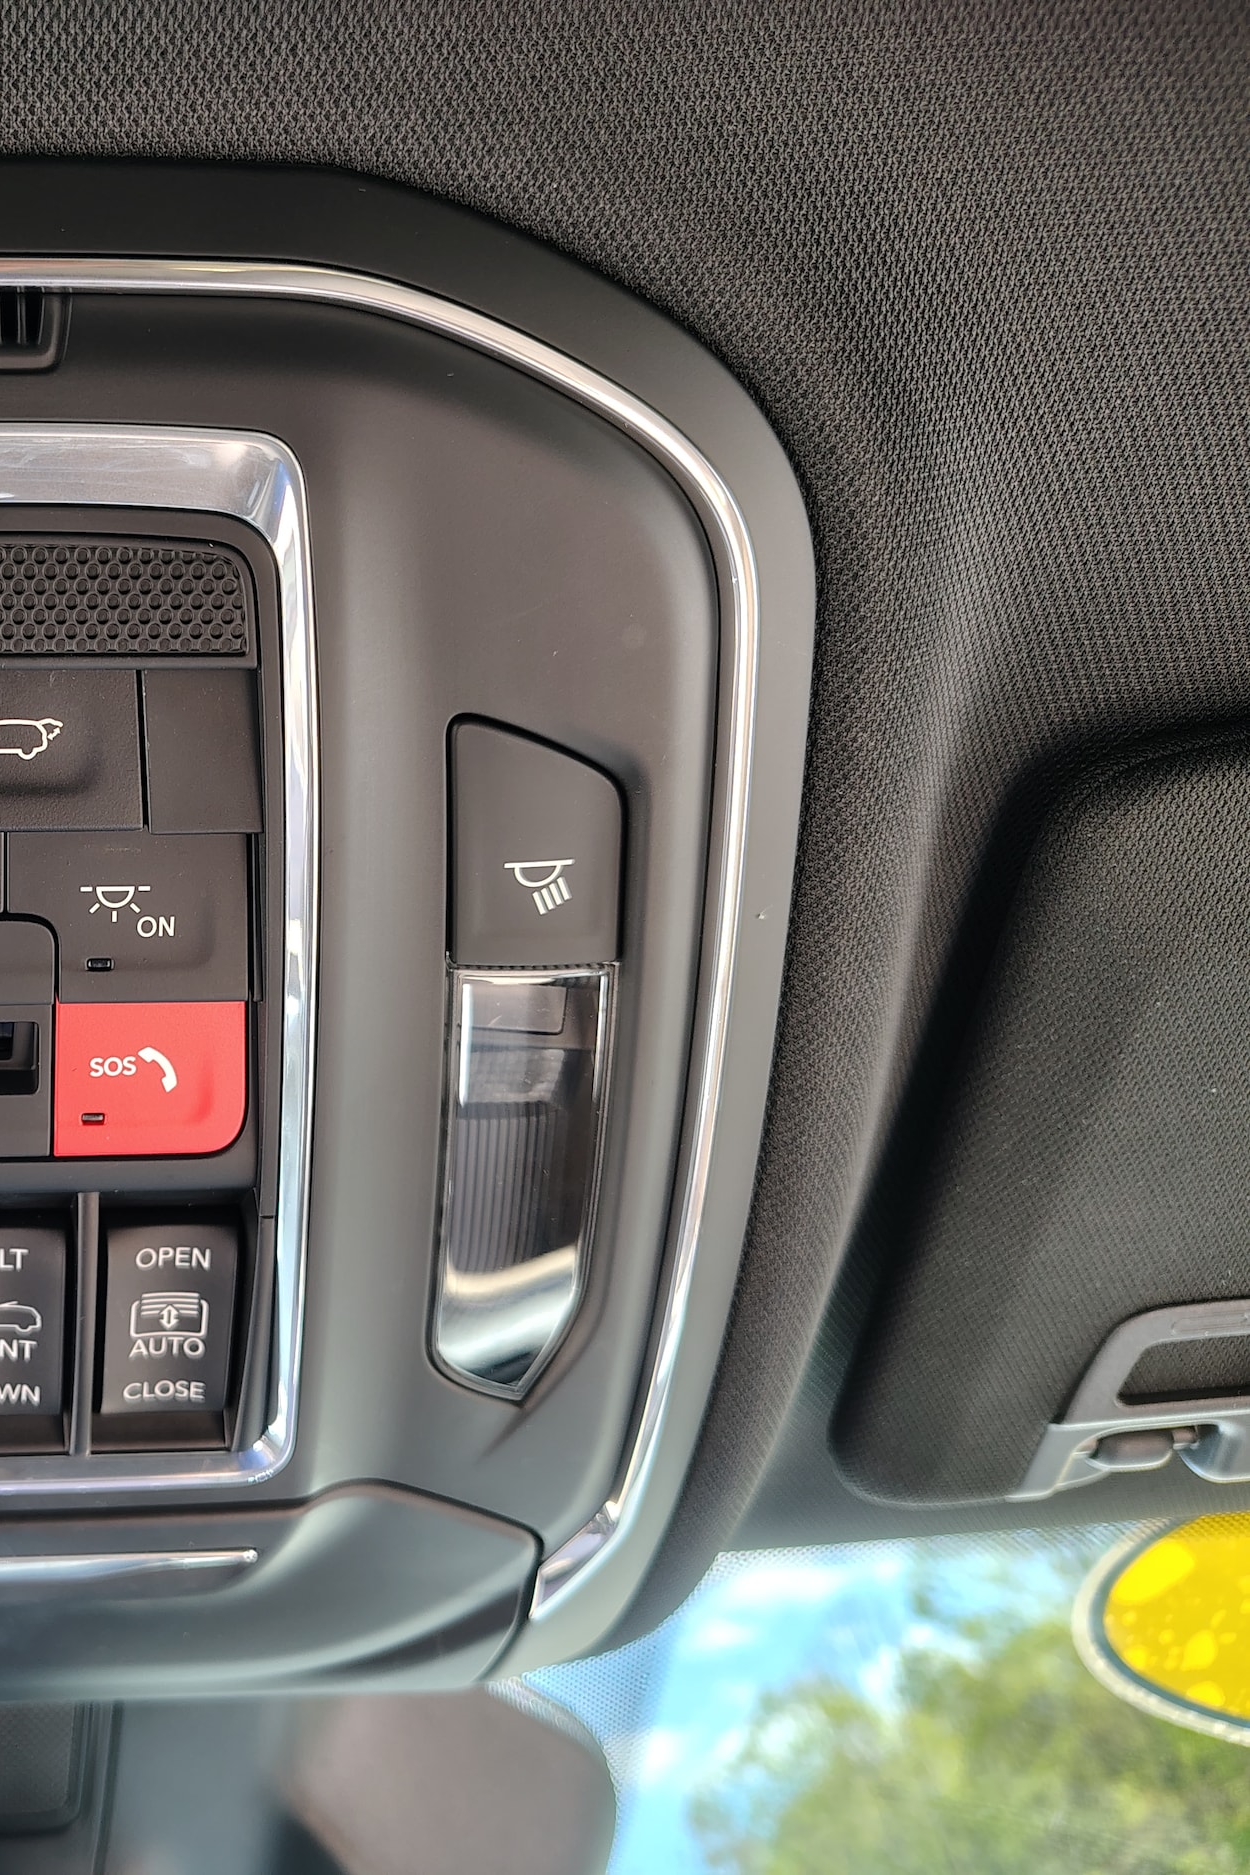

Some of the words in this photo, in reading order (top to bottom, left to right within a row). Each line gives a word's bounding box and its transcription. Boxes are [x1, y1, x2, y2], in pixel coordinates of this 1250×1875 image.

[136, 916, 176, 938] ON
[89, 1056, 137, 1078] SOS
[135, 1247, 212, 1270] OPEN
[128, 1336, 206, 1358] AUTO
[122, 1379, 207, 1402] CLOSE
